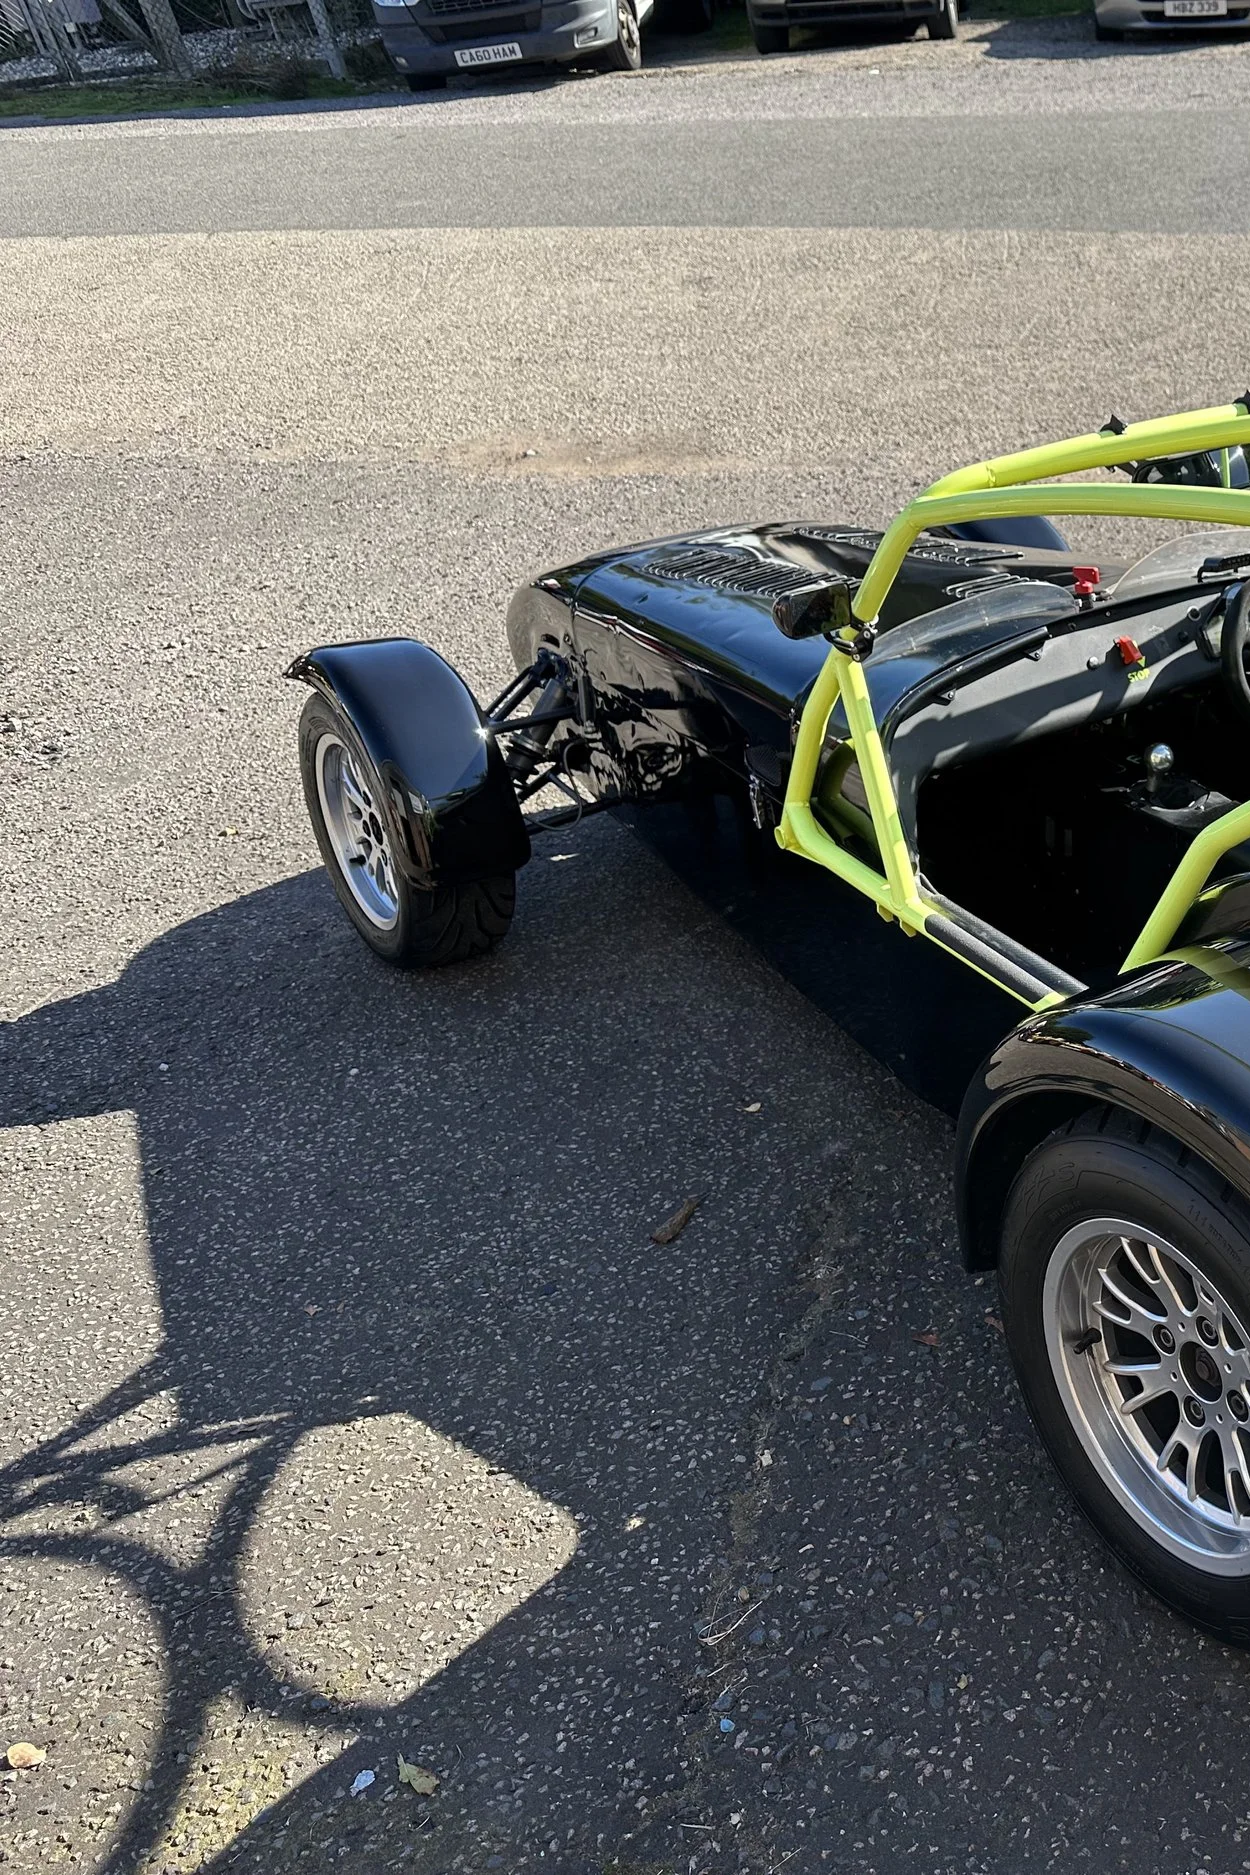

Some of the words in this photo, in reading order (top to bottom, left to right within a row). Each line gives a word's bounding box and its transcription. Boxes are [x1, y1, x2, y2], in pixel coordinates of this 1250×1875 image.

[460, 49, 491, 64] CA60
[492, 45, 517, 60] HAM
[1127, 668, 1150, 683] STOP
